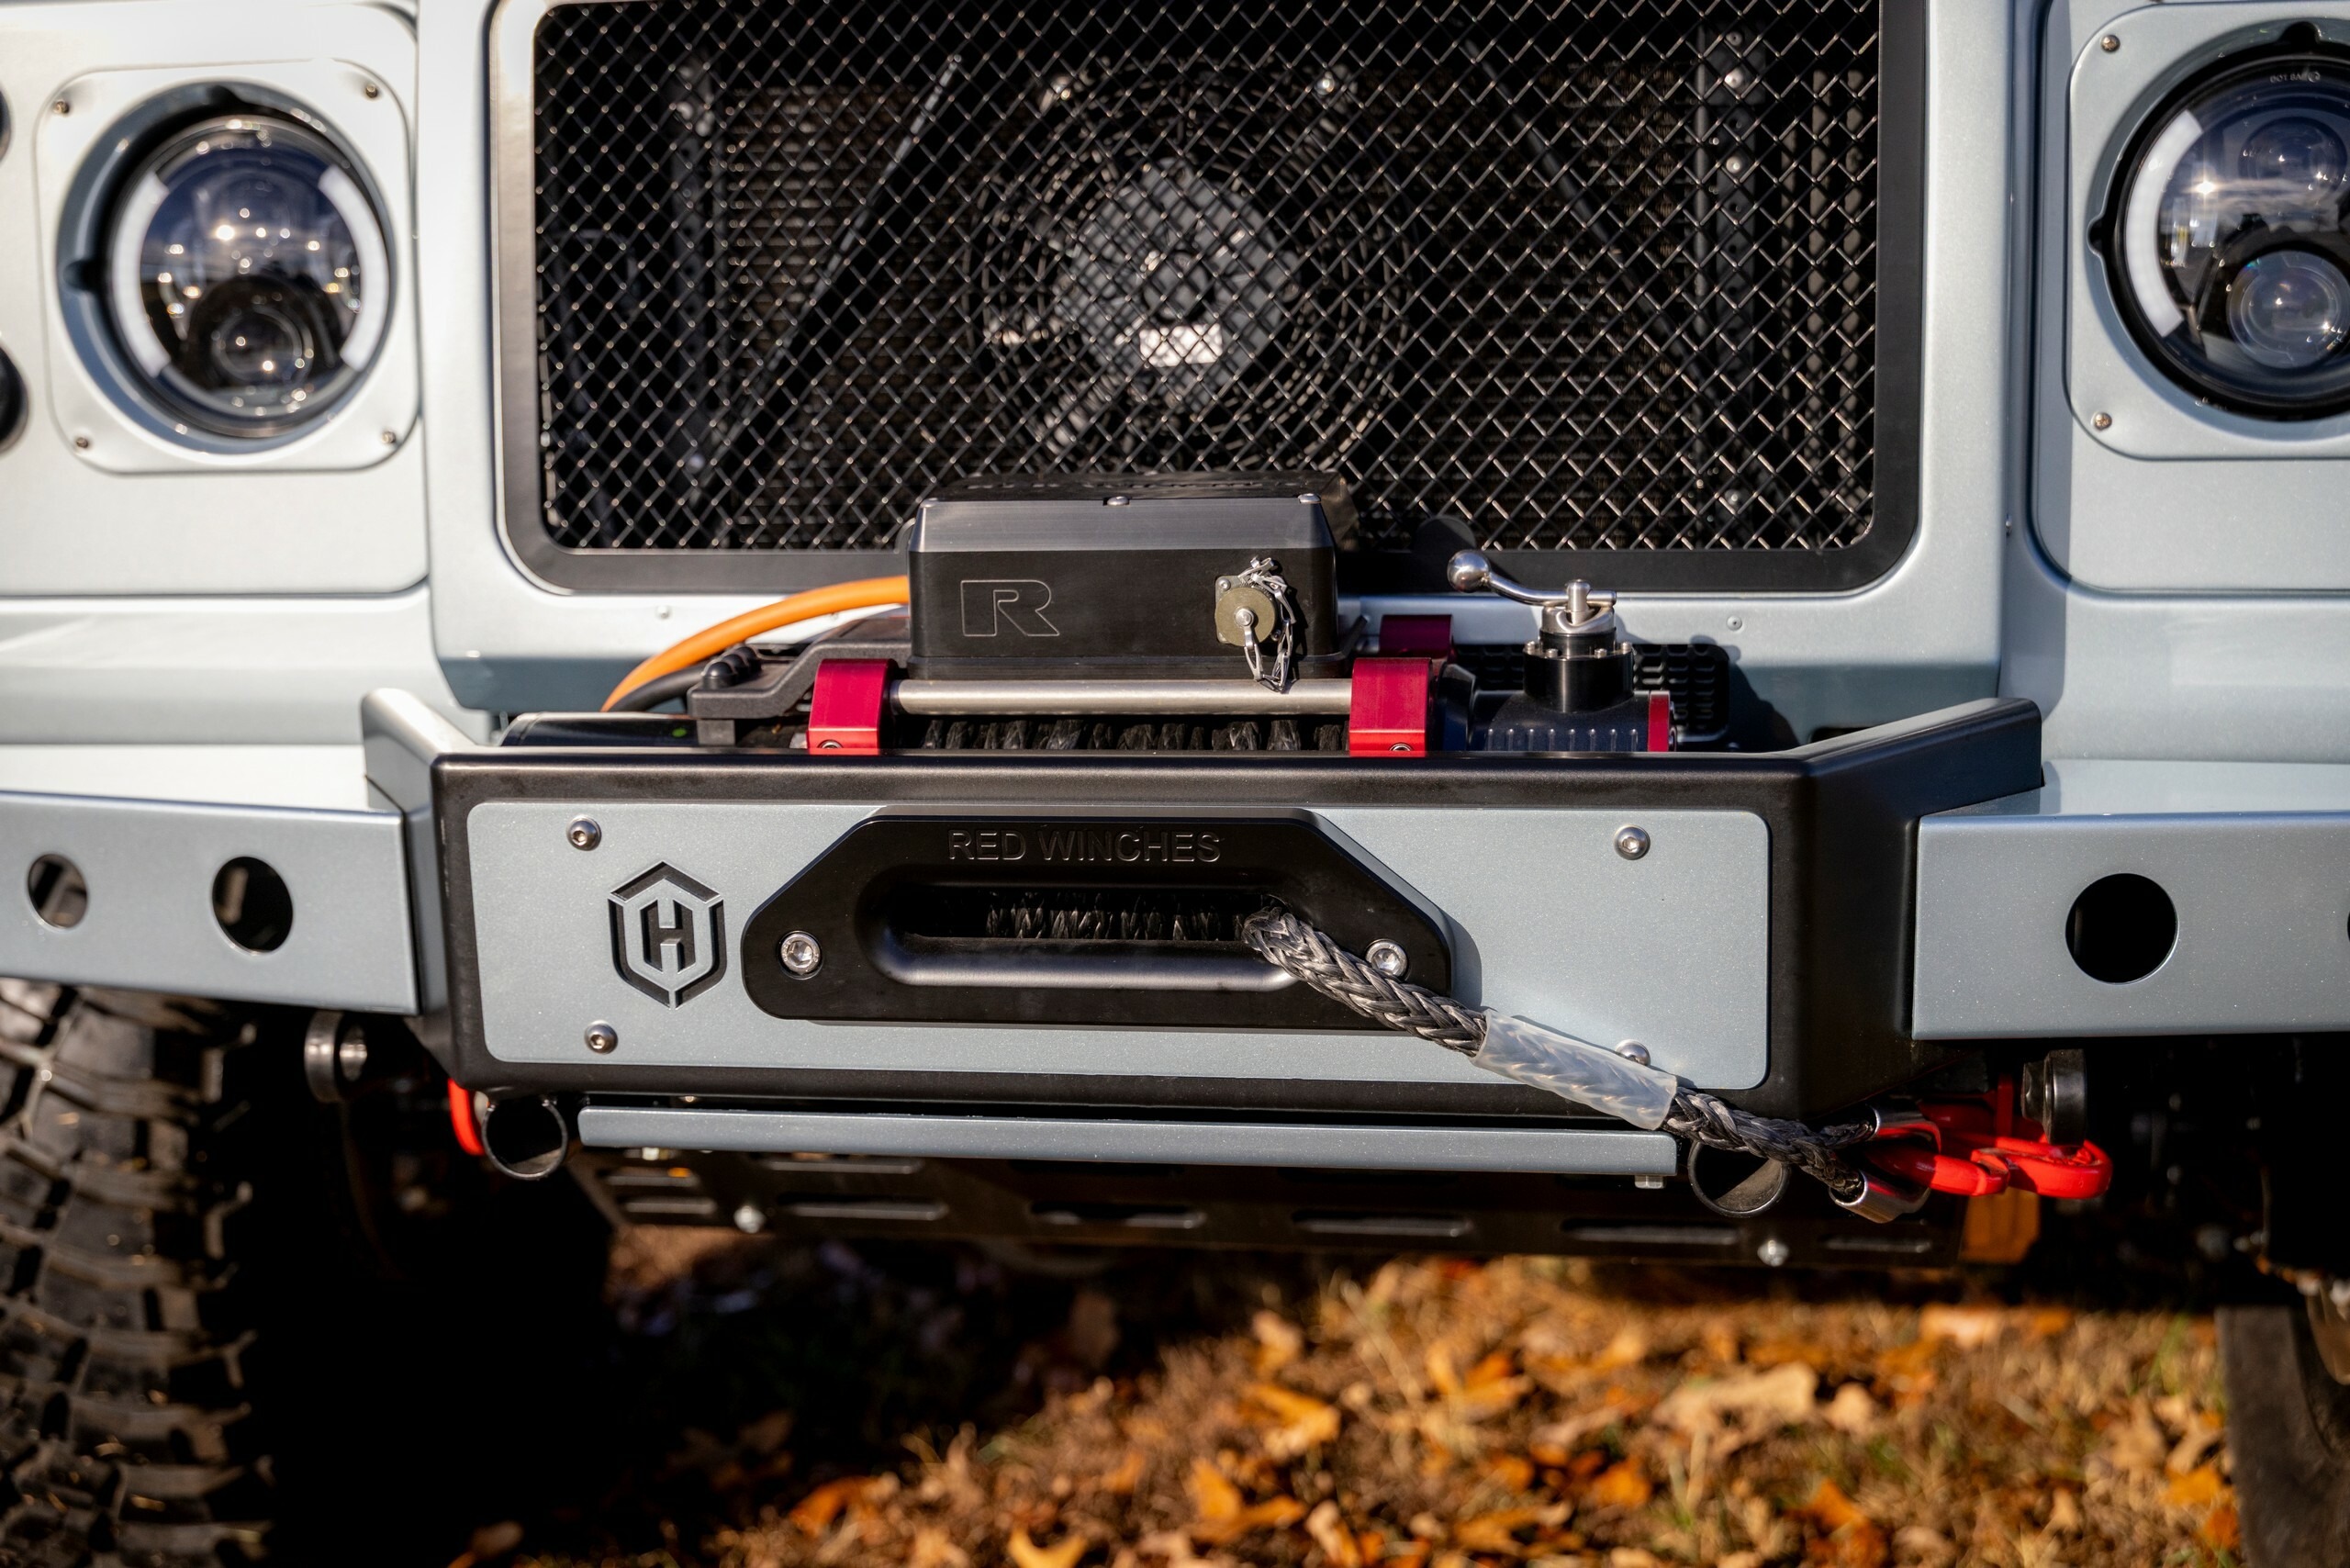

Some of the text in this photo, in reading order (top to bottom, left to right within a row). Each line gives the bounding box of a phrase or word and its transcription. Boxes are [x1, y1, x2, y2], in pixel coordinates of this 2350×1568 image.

[2270, 73, 2288, 83] DOT
[960, 579, 1060, 637] R
[948, 830, 1222, 862] RED WINCHES
